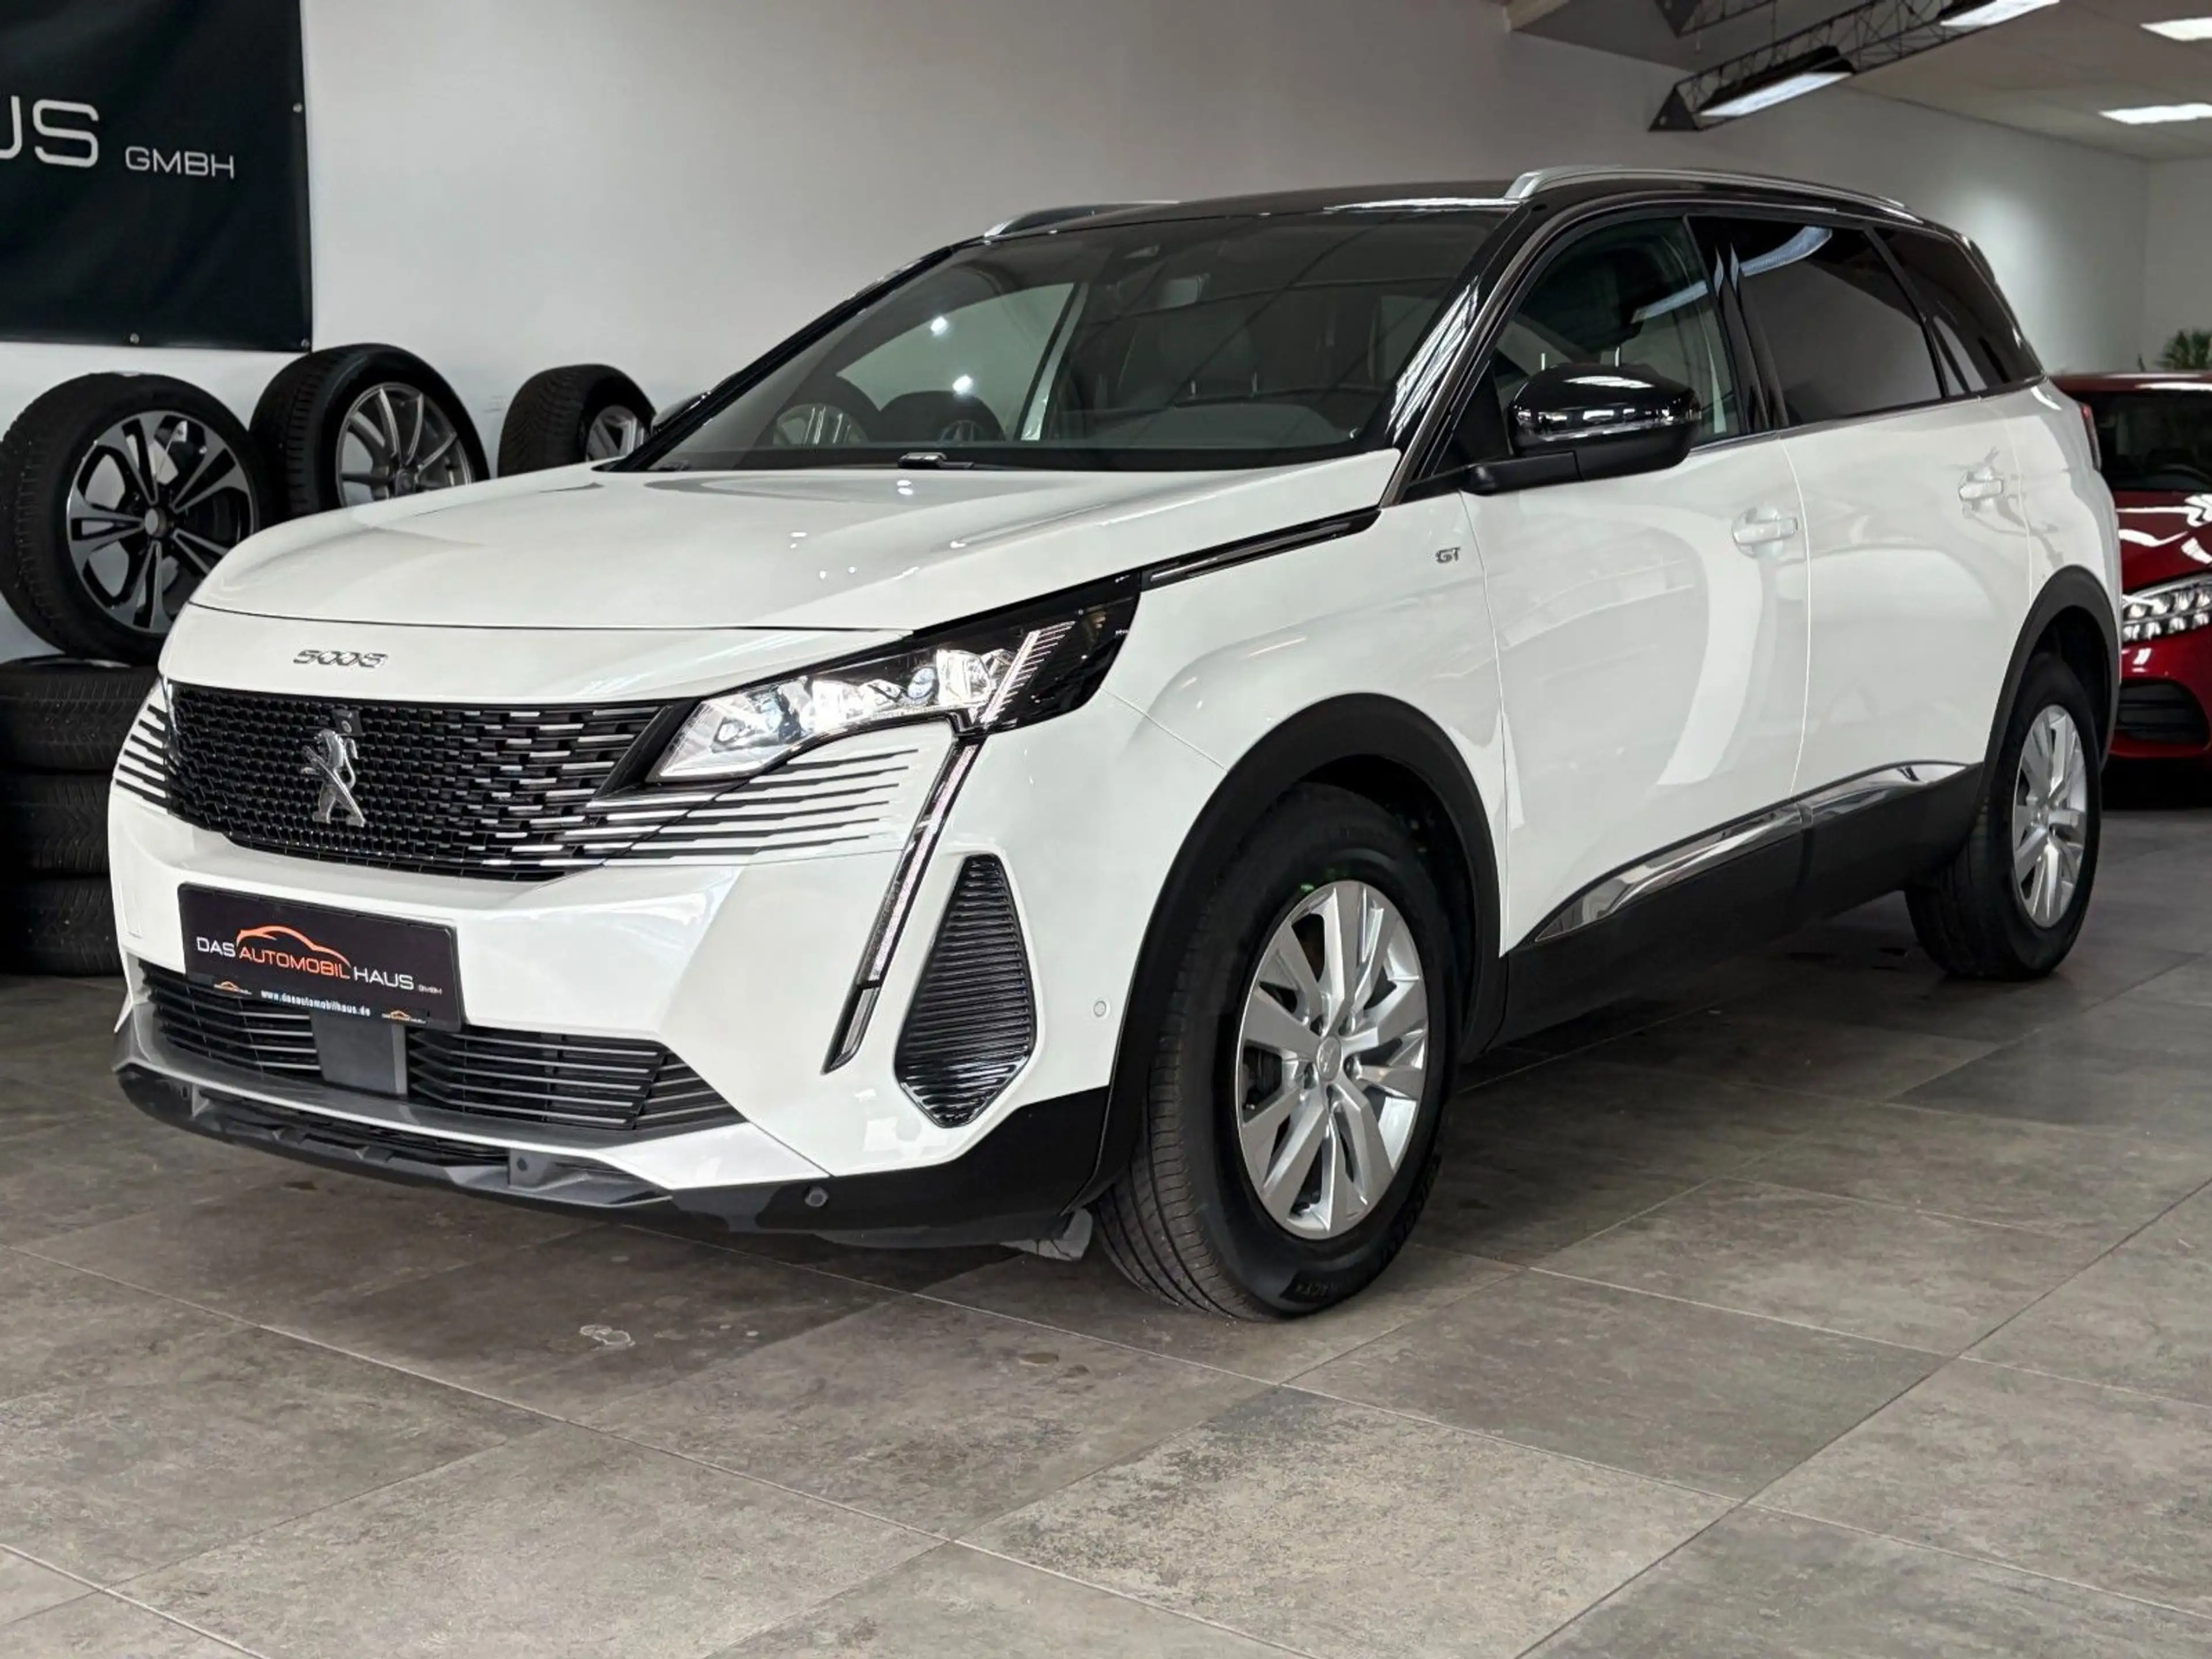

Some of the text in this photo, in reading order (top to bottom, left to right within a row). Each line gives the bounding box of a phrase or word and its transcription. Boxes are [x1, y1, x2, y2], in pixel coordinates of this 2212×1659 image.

[125, 146, 234, 179] GMBH
[1435, 546, 1461, 564] GT
[196, 937, 236, 957] DAS
[239, 946, 350, 979] AUTOMOBIL
[353, 966, 414, 991] HAUS
[261, 990, 371, 1018] www.dasautomobilhaus.de
